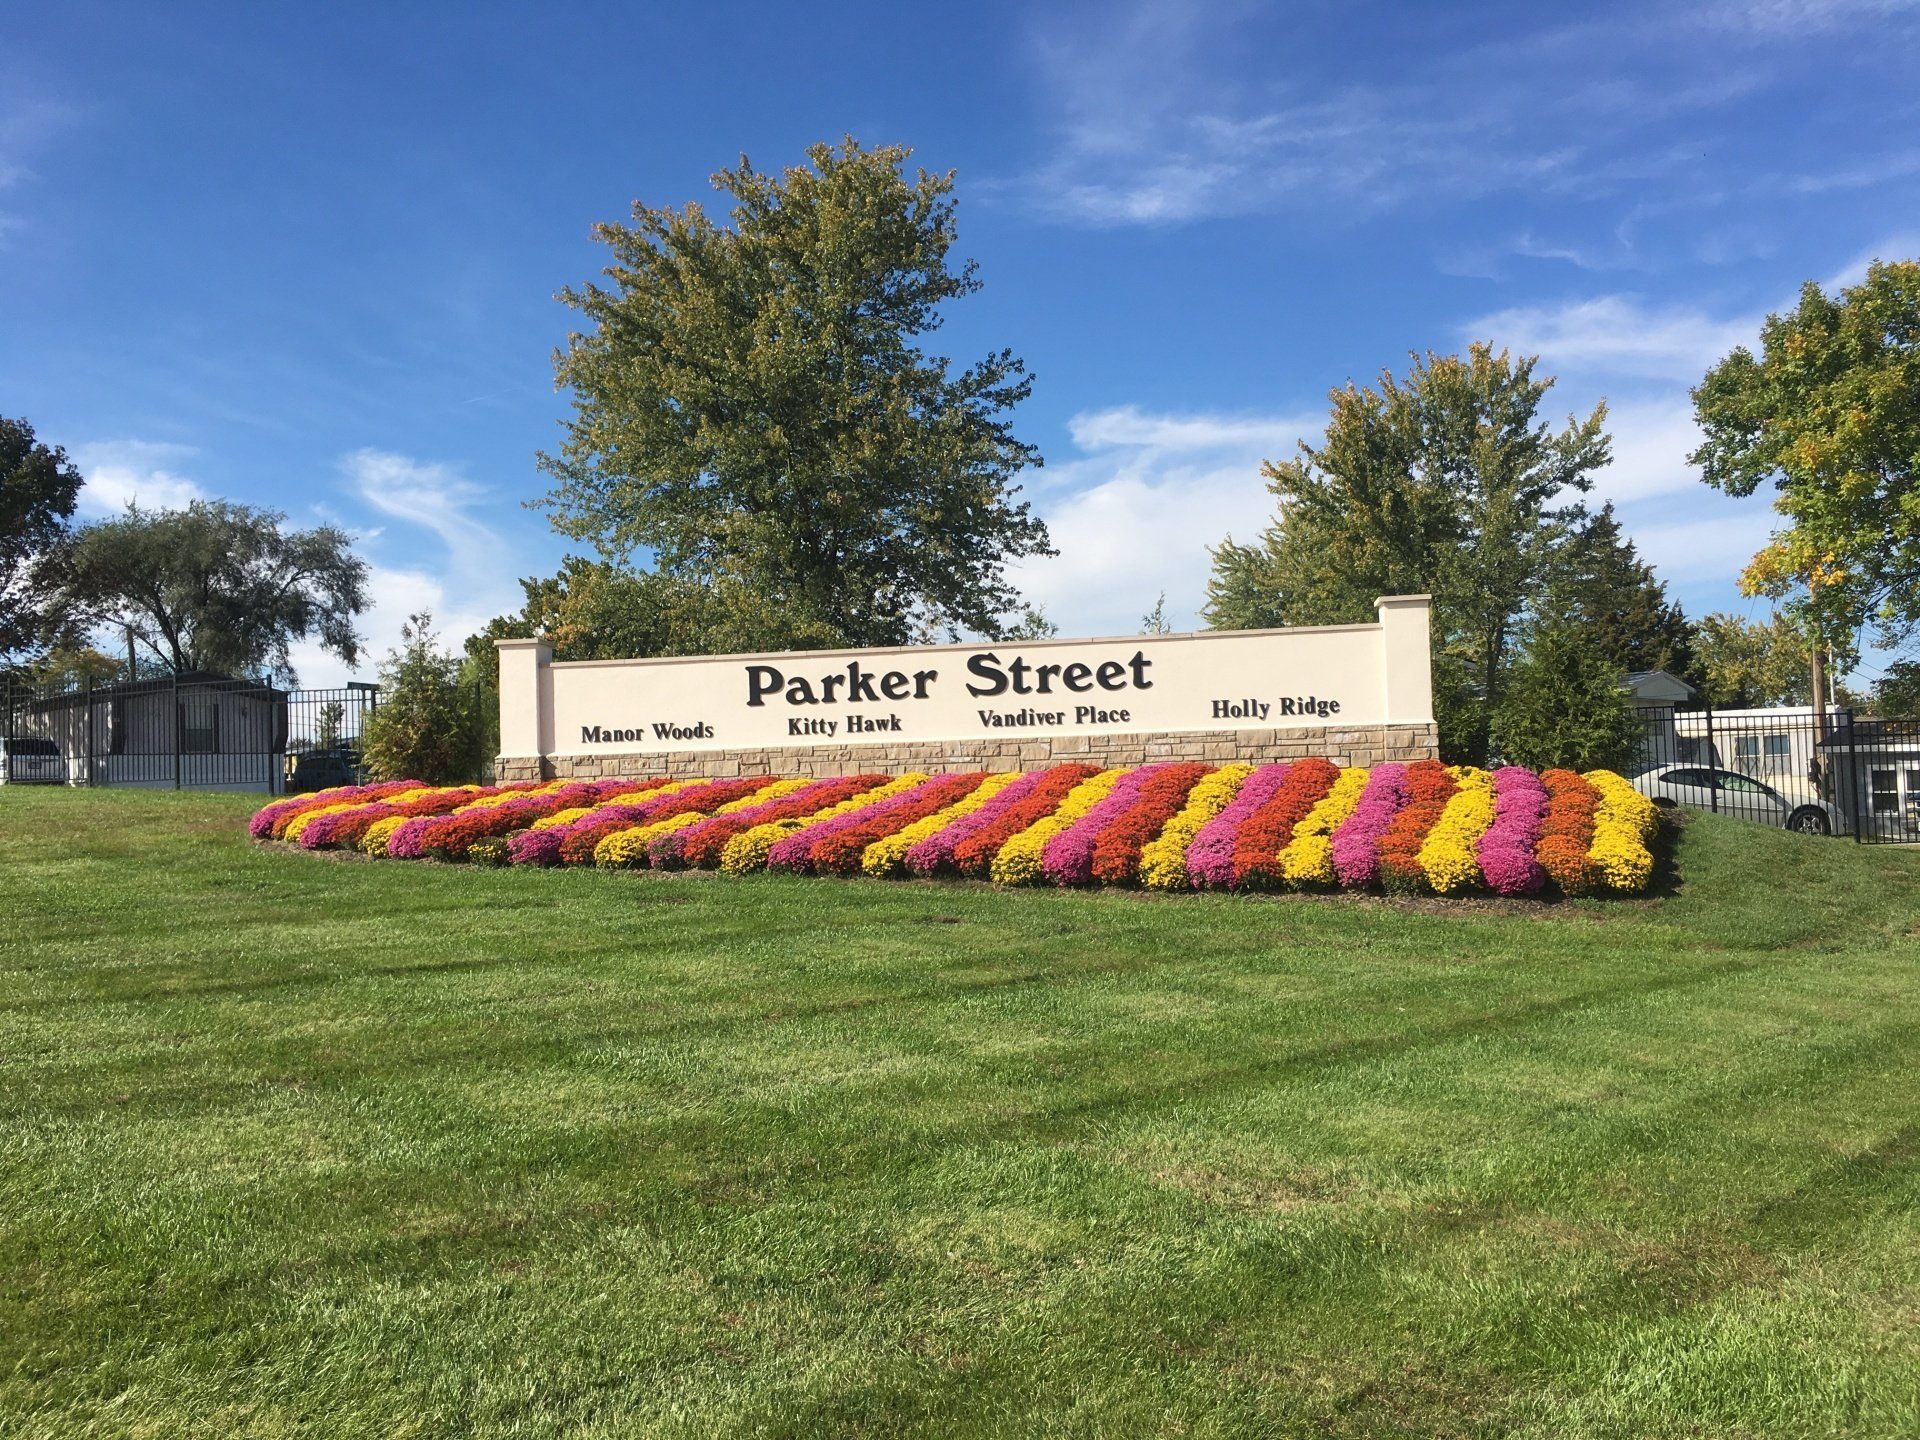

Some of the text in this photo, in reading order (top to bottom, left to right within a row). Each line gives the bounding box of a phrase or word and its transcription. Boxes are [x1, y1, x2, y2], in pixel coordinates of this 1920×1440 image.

[745, 650, 1153, 707] Parker Street
[977, 705, 1130, 727] Vandiver Place
[1211, 696, 1340, 720] Holly Ridge
[581, 721, 714, 744] Manor Woods
[788, 713, 902, 738] Kitty Hawk
